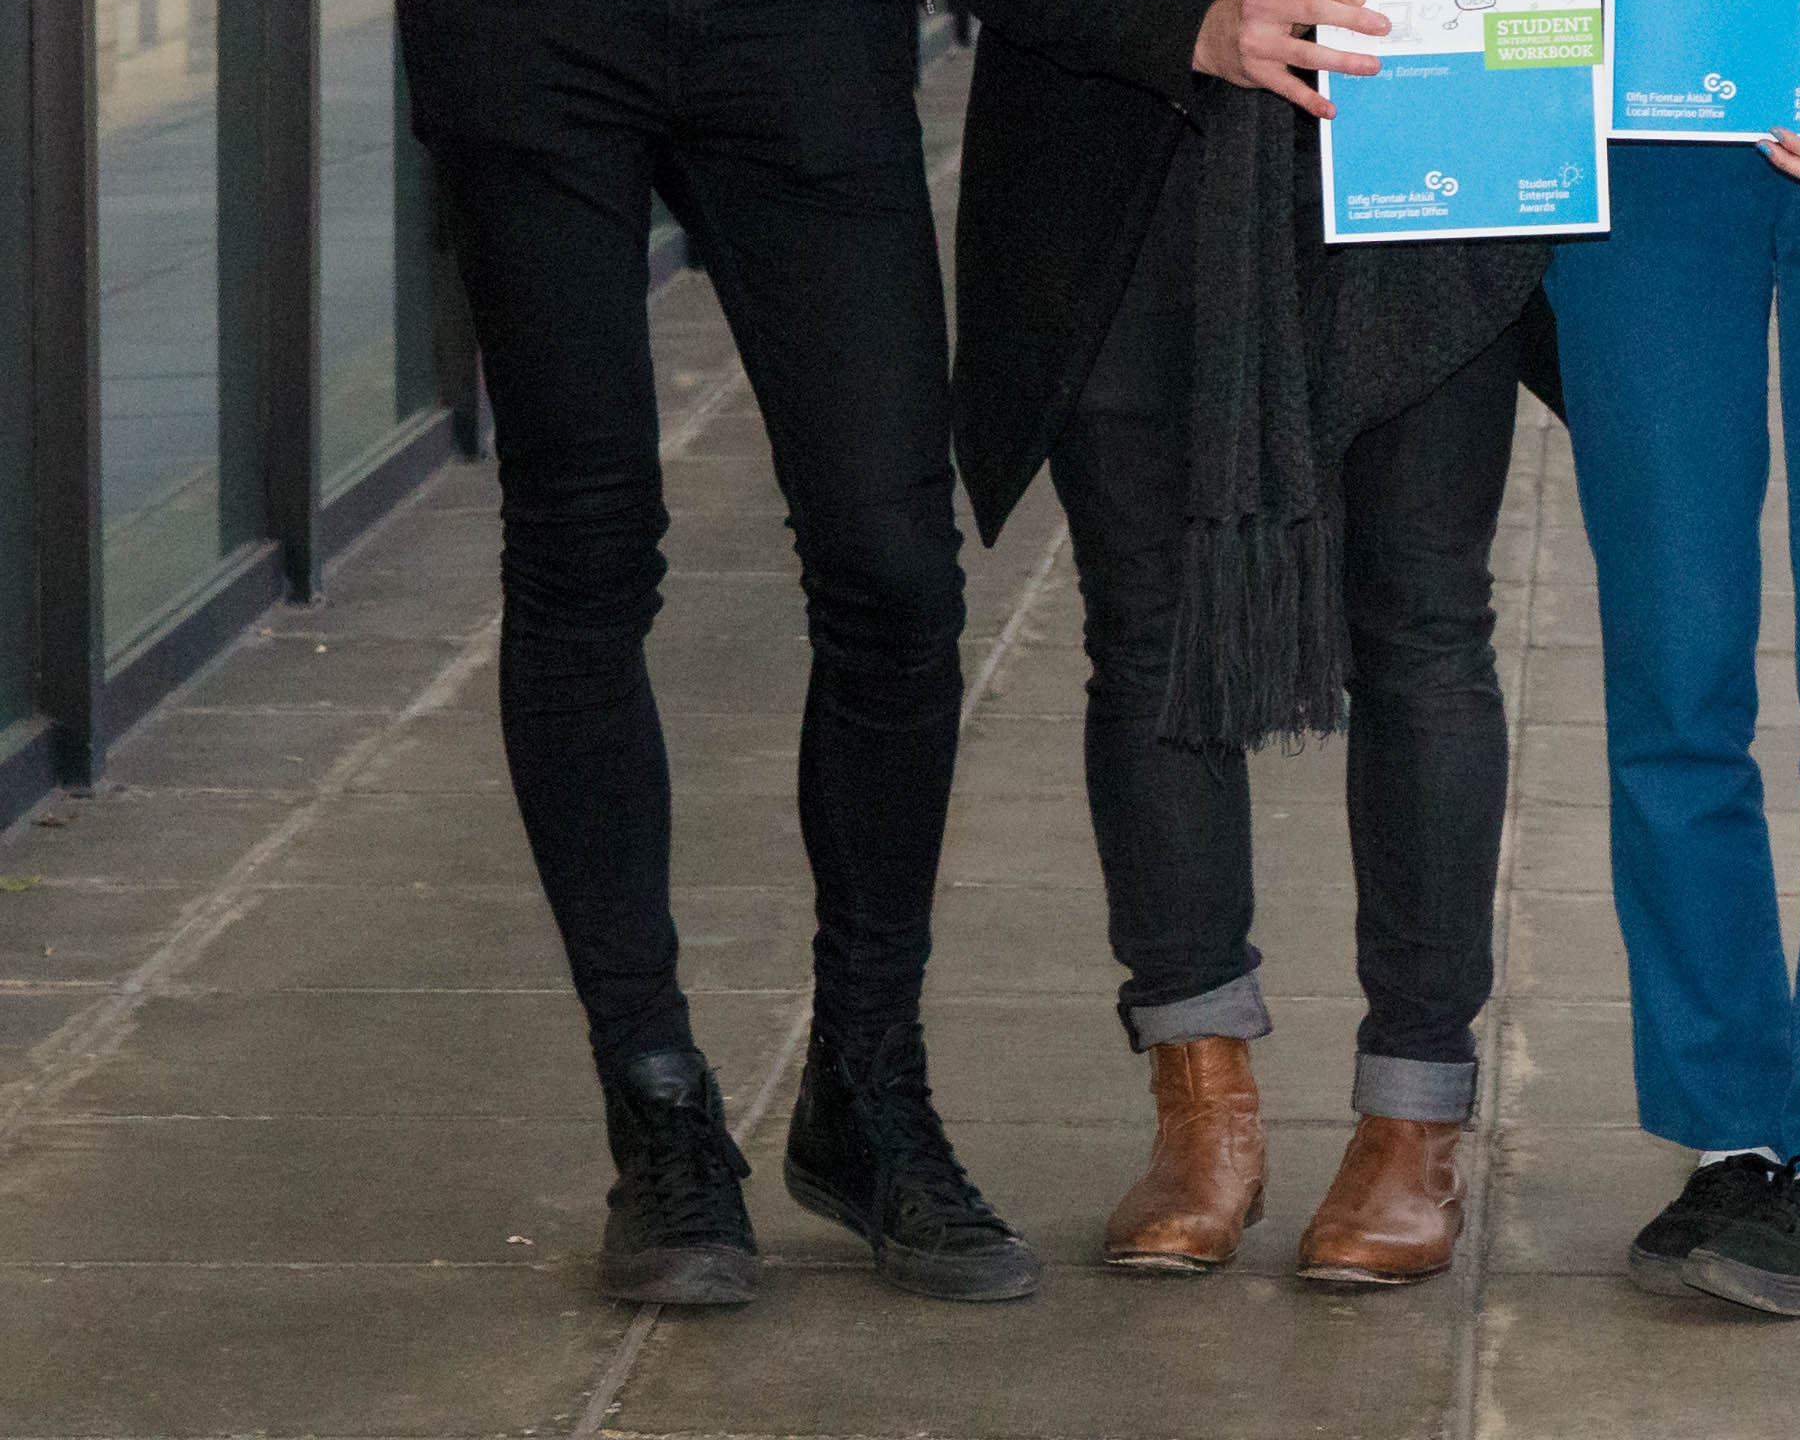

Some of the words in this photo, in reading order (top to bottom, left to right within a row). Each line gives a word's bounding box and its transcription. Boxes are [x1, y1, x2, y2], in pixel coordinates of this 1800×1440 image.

[1497, 16, 1592, 35] STUDENT
[1498, 44, 1593, 61] WORKBOOK
[1626, 106, 1649, 117] Local
[1651, 107, 1697, 118] Enterprise
[1698, 108, 1725, 118] Office
[1518, 179, 1557, 189] Student
[1518, 190, 1569, 201] Enterprise
[1348, 210, 1373, 220] Local
[1374, 208, 1420, 219] Enterprise
[1421, 206, 1449, 217] Office
[1519, 203, 1555, 212] Awards
